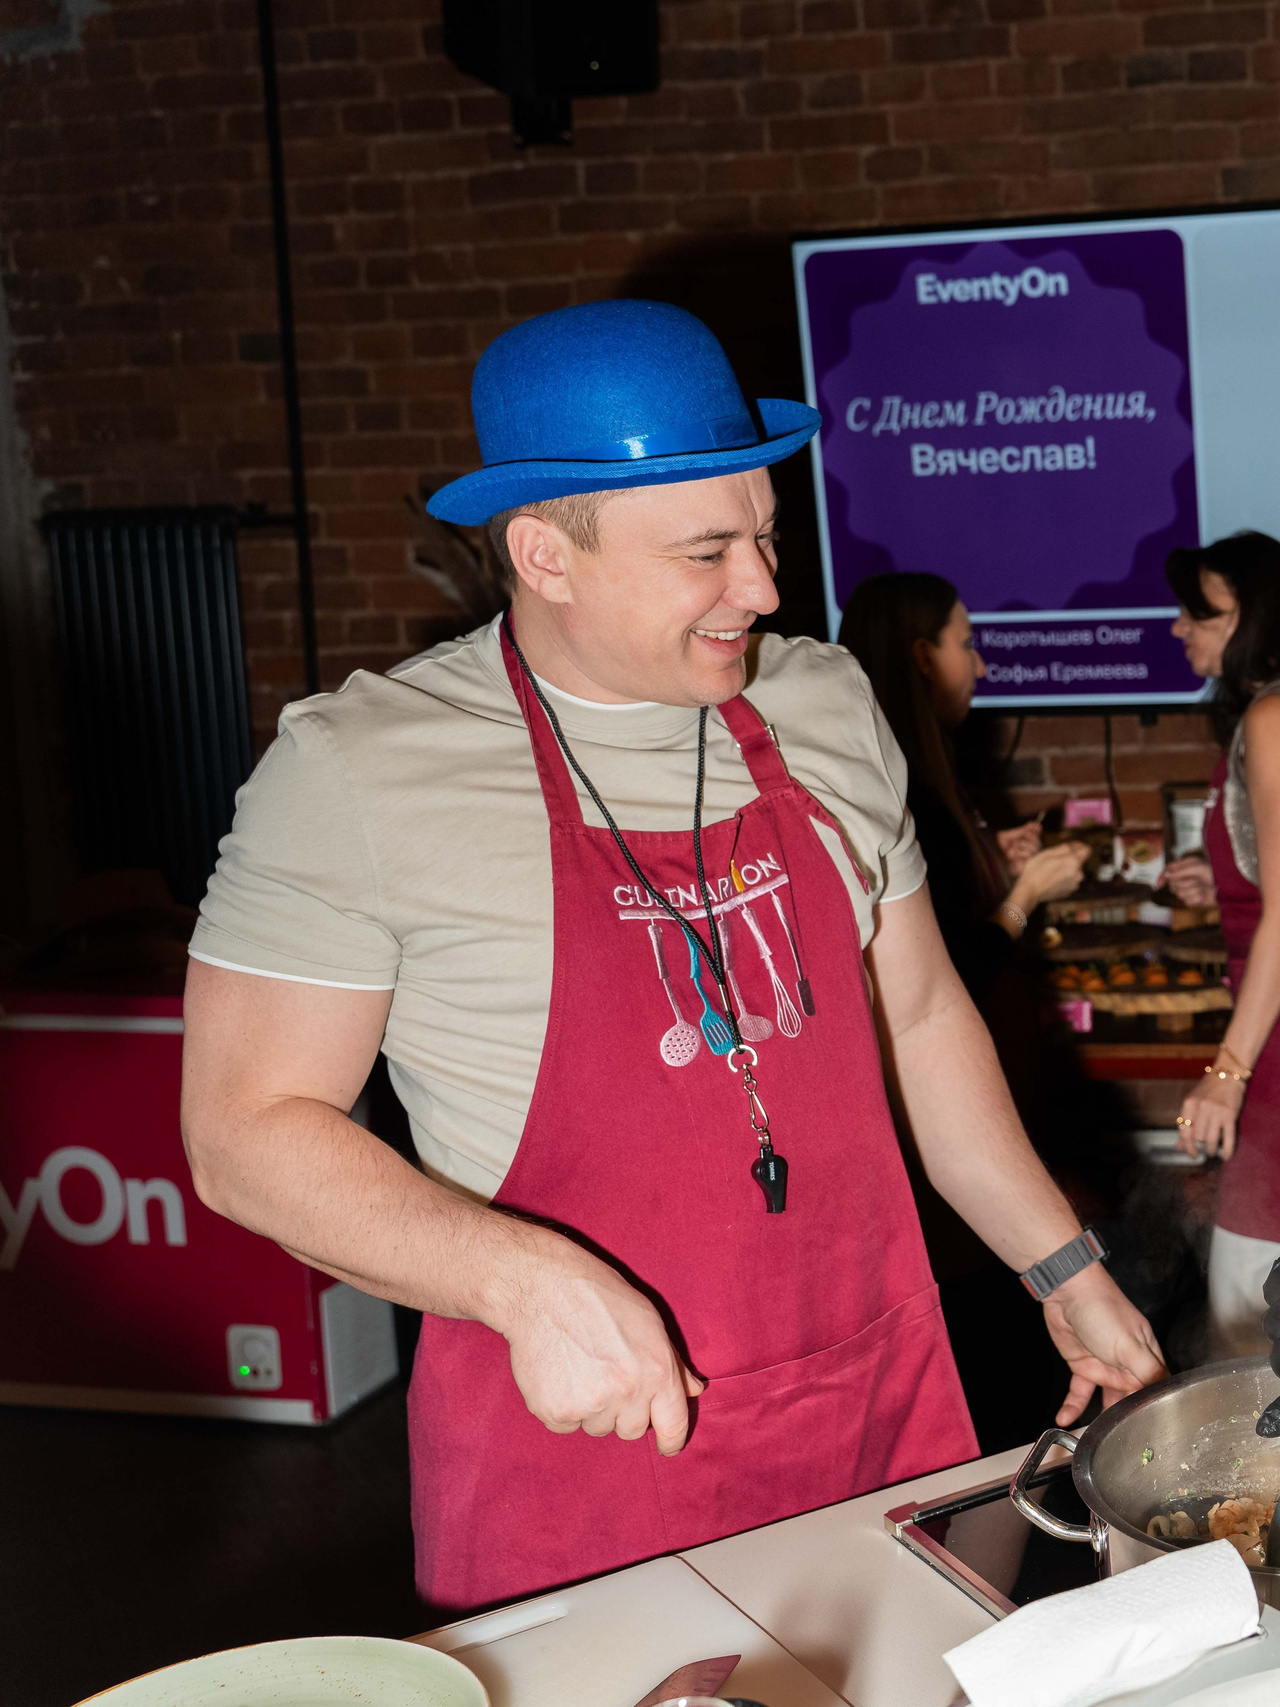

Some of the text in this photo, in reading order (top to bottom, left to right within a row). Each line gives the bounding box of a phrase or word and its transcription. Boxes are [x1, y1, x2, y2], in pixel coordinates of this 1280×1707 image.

[916, 267, 1069, 306] EventyOn
[846, 385, 1157, 437] С Днем Рождения,
[910, 435, 1097, 477] Вячеслав!
[1095, 625, 1145, 645] Олег
[986, 661, 1149, 686] Софья Еремеева
[0, 1145, 188, 1271] yOn
